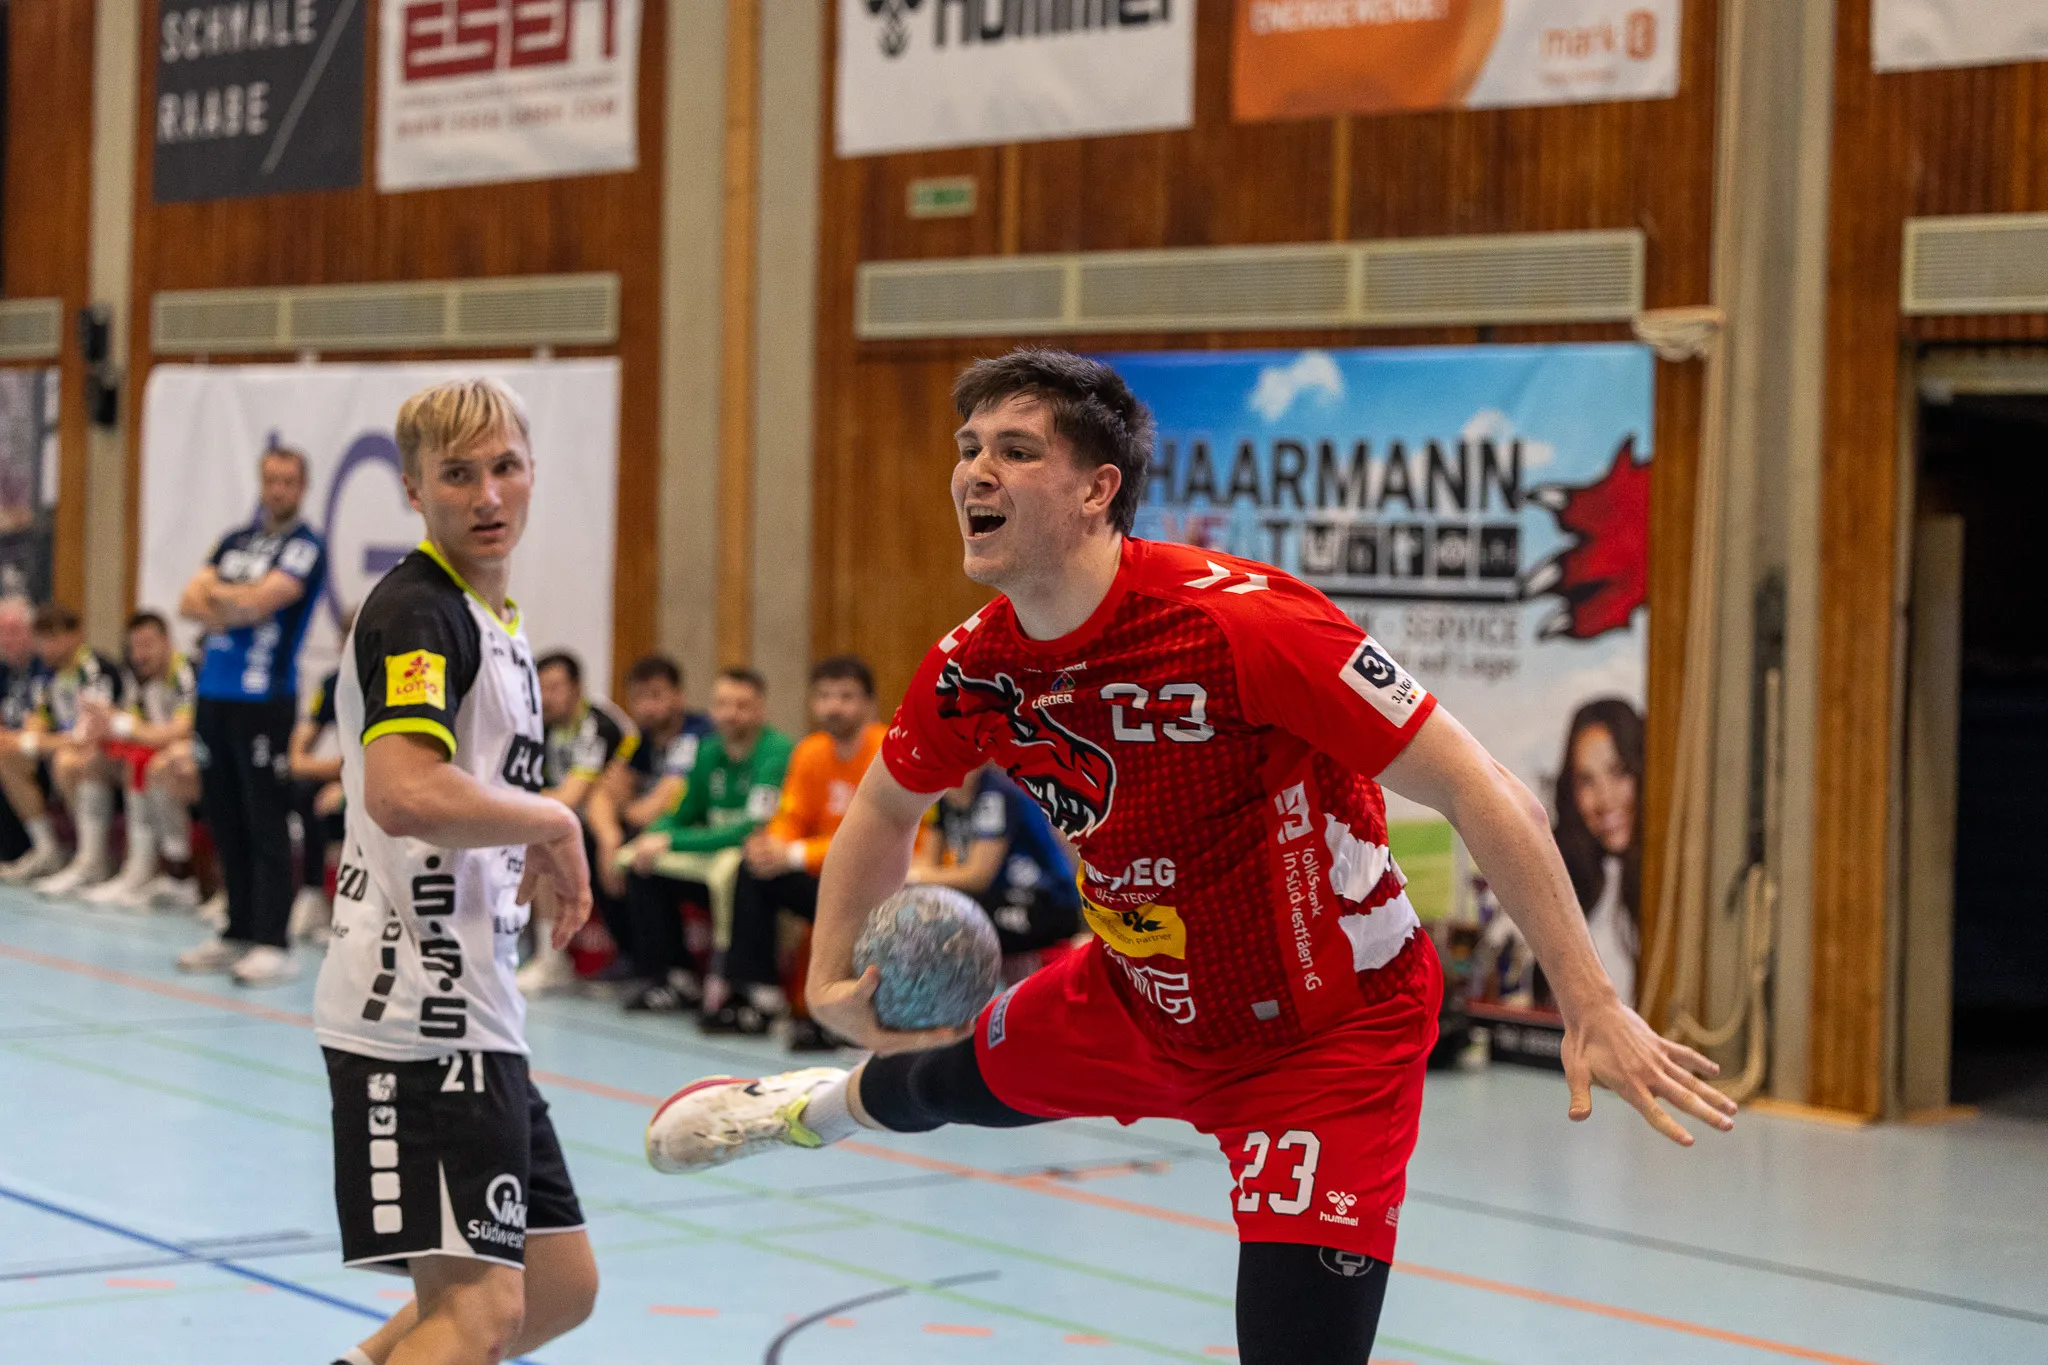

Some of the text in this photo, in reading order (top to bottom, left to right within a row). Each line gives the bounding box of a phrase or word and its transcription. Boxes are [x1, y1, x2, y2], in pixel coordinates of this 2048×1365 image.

[157, 82, 270, 144] RAABE
[1141, 434, 1524, 514] HAARMANN
[1100, 682, 1216, 742] 23
[1282, 850, 1301, 871] in
[437, 1051, 487, 1093] 21
[1237, 1128, 1321, 1216] 23
[466, 1219, 526, 1250] Südwes
[1319, 1210, 1359, 1227] hummel
